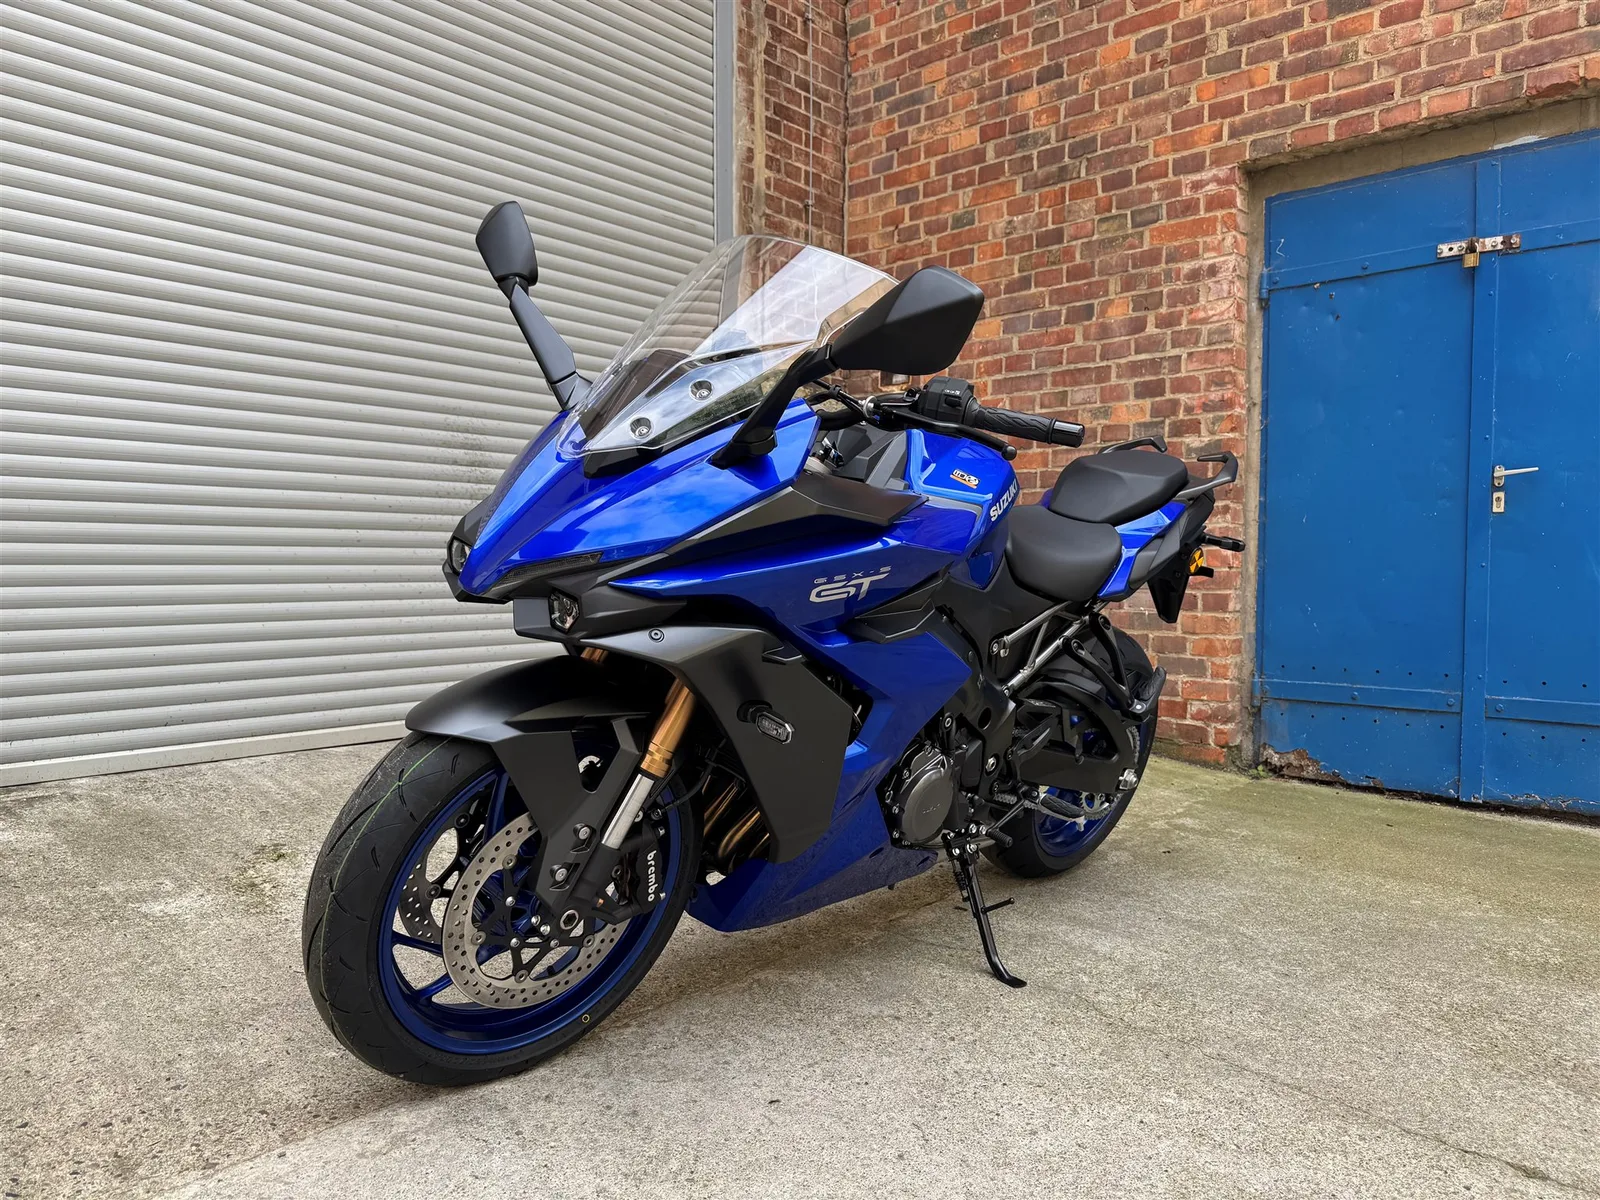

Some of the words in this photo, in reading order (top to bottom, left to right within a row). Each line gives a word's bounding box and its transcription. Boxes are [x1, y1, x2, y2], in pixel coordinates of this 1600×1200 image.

[989, 478, 1018, 522] SUZUKI
[809, 573, 890, 603] GT
[647, 850, 659, 902] brembo
